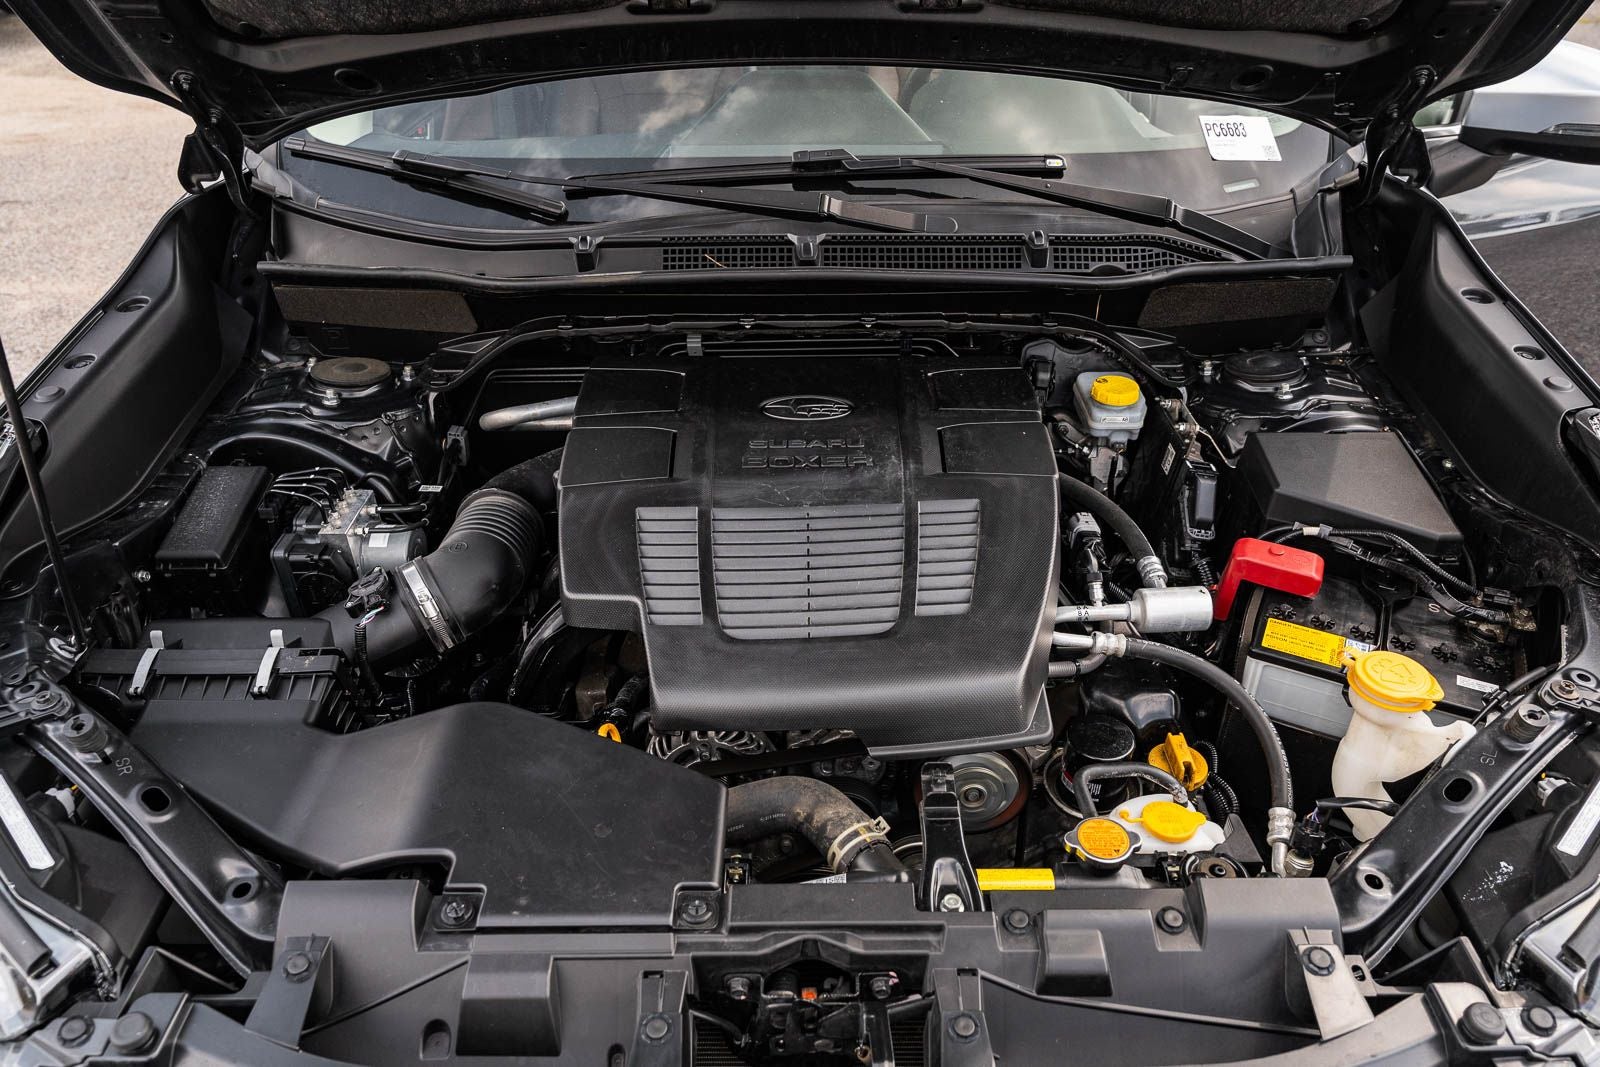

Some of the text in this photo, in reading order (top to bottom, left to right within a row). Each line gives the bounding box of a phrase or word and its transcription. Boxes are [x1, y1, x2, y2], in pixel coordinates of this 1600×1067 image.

[1205, 123, 1247, 137] PC6683
[749, 438, 865, 449] SUBARU
[741, 455, 874, 469] BOXER
[115, 757, 133, 776] SR
